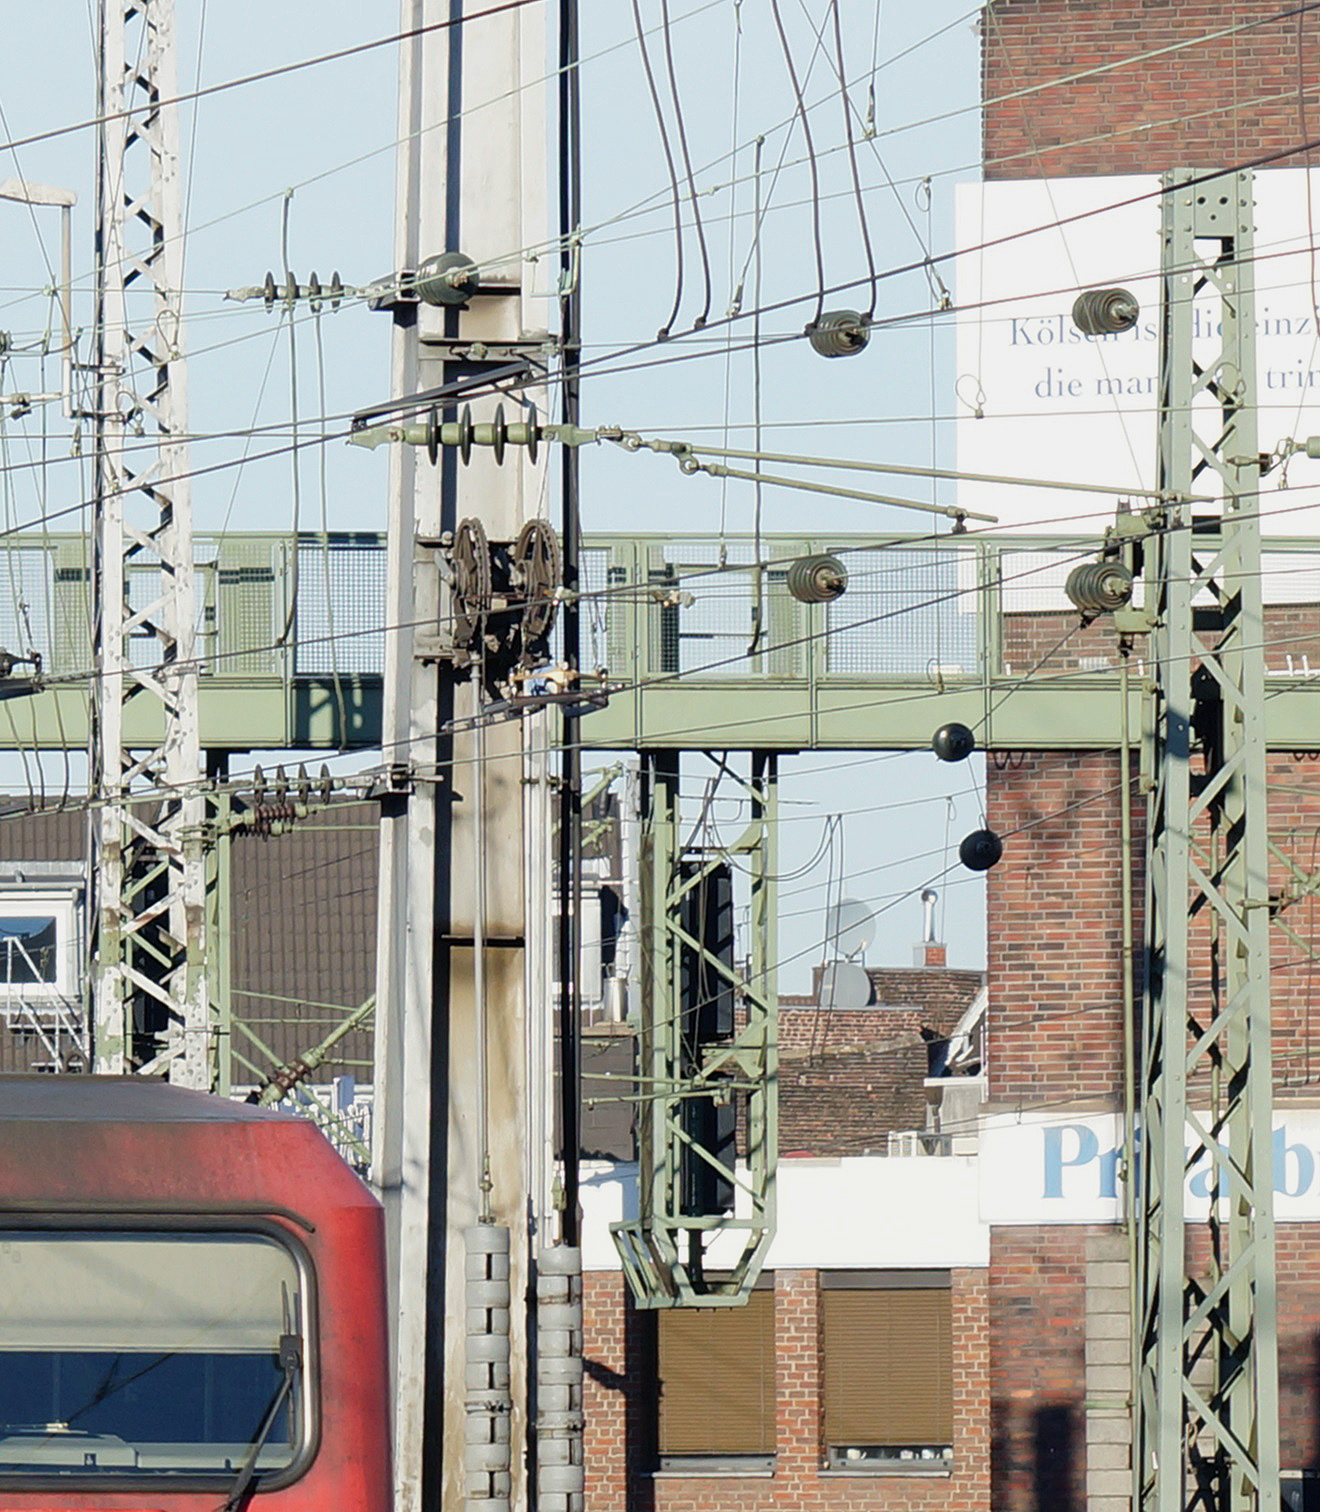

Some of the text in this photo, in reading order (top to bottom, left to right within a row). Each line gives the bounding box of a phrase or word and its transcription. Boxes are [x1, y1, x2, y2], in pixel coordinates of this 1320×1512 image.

[1010, 314, 1118, 346] Köls
[1133, 322, 1158, 342] is
[1034, 366, 1083, 398] die
